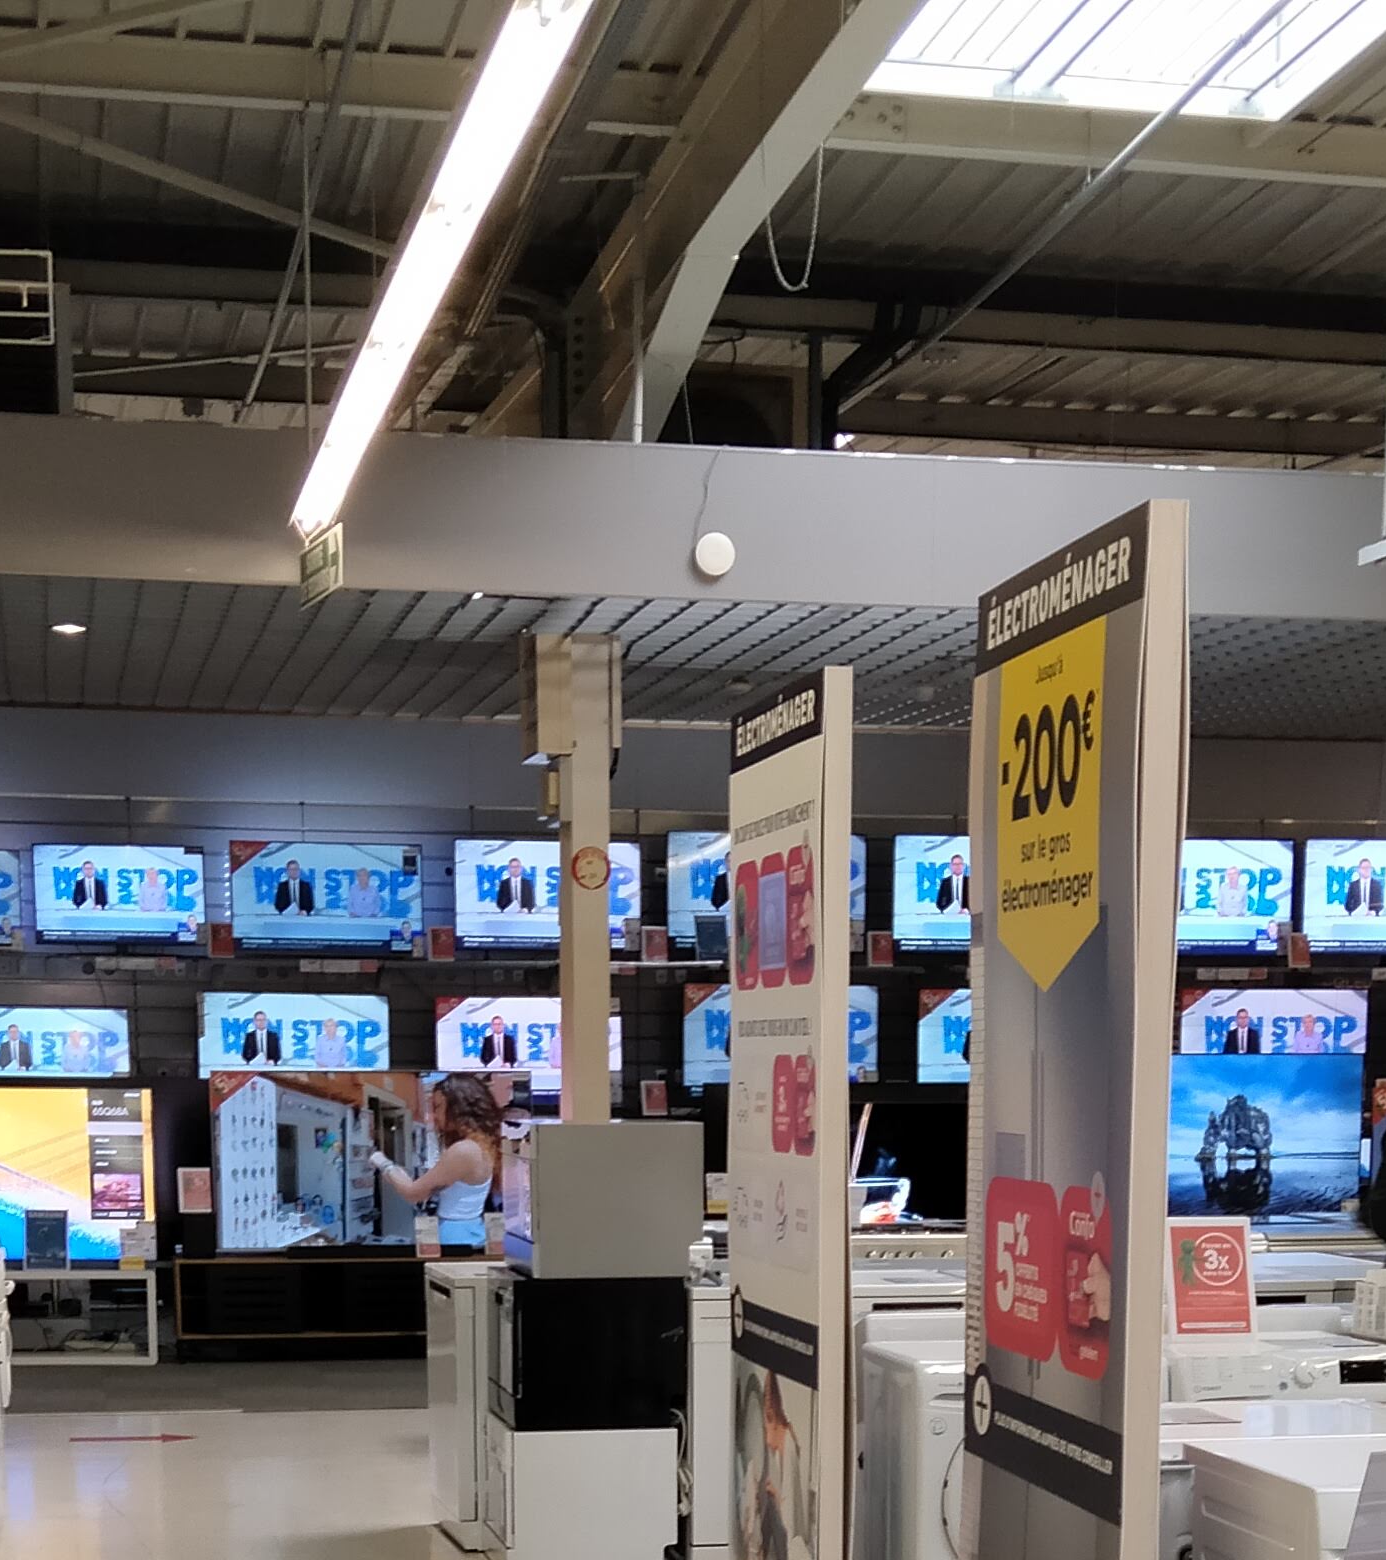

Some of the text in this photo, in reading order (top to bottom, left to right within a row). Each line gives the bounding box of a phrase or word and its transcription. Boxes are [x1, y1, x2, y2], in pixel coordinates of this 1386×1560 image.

[987, 535, 1132, 651] ÉLECTROMÉNAGER
[736, 690, 816, 758] ÉLECTROMÉNAGER
[1021, 832, 1071, 863] sur le gros
[1002, 868, 1094, 913] électroménager
[1203, 1249, 1230, 1271] 3x
